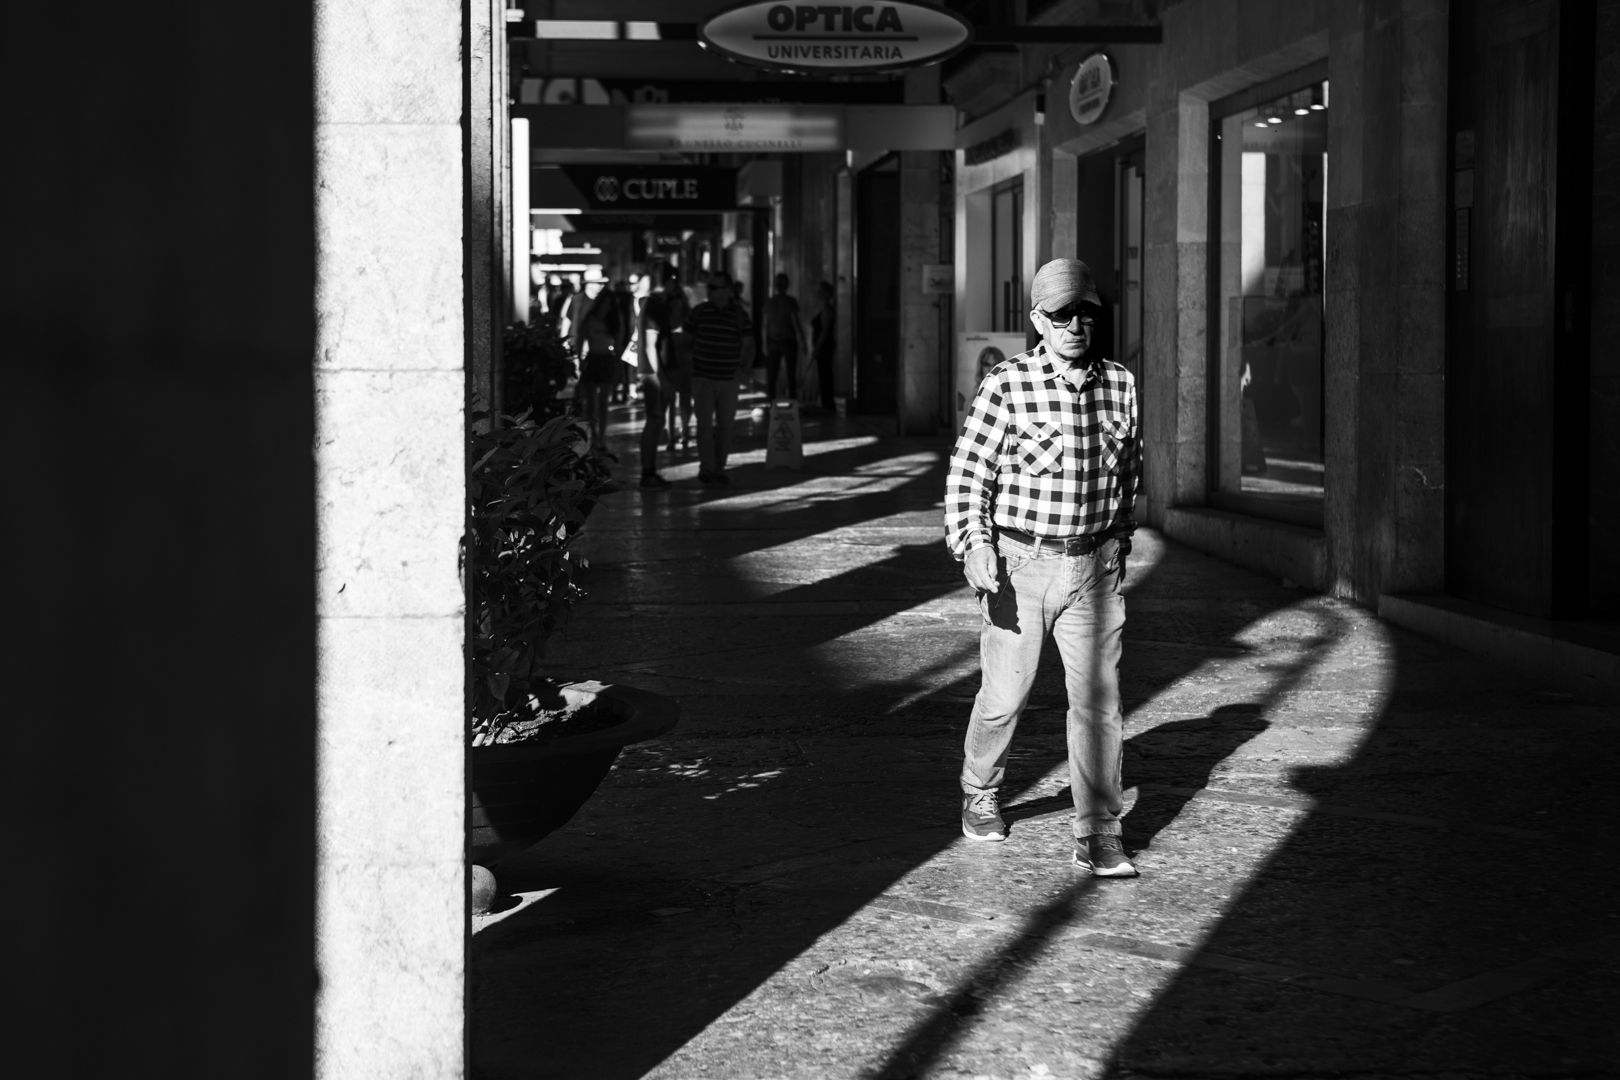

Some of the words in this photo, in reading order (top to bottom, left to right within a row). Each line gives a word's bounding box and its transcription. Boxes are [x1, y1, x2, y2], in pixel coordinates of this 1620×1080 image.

[768, 5, 903, 31] OPTICA
[768, 46, 904, 60] UNIVERSITARIA
[622, 178, 699, 199] CUPLE
